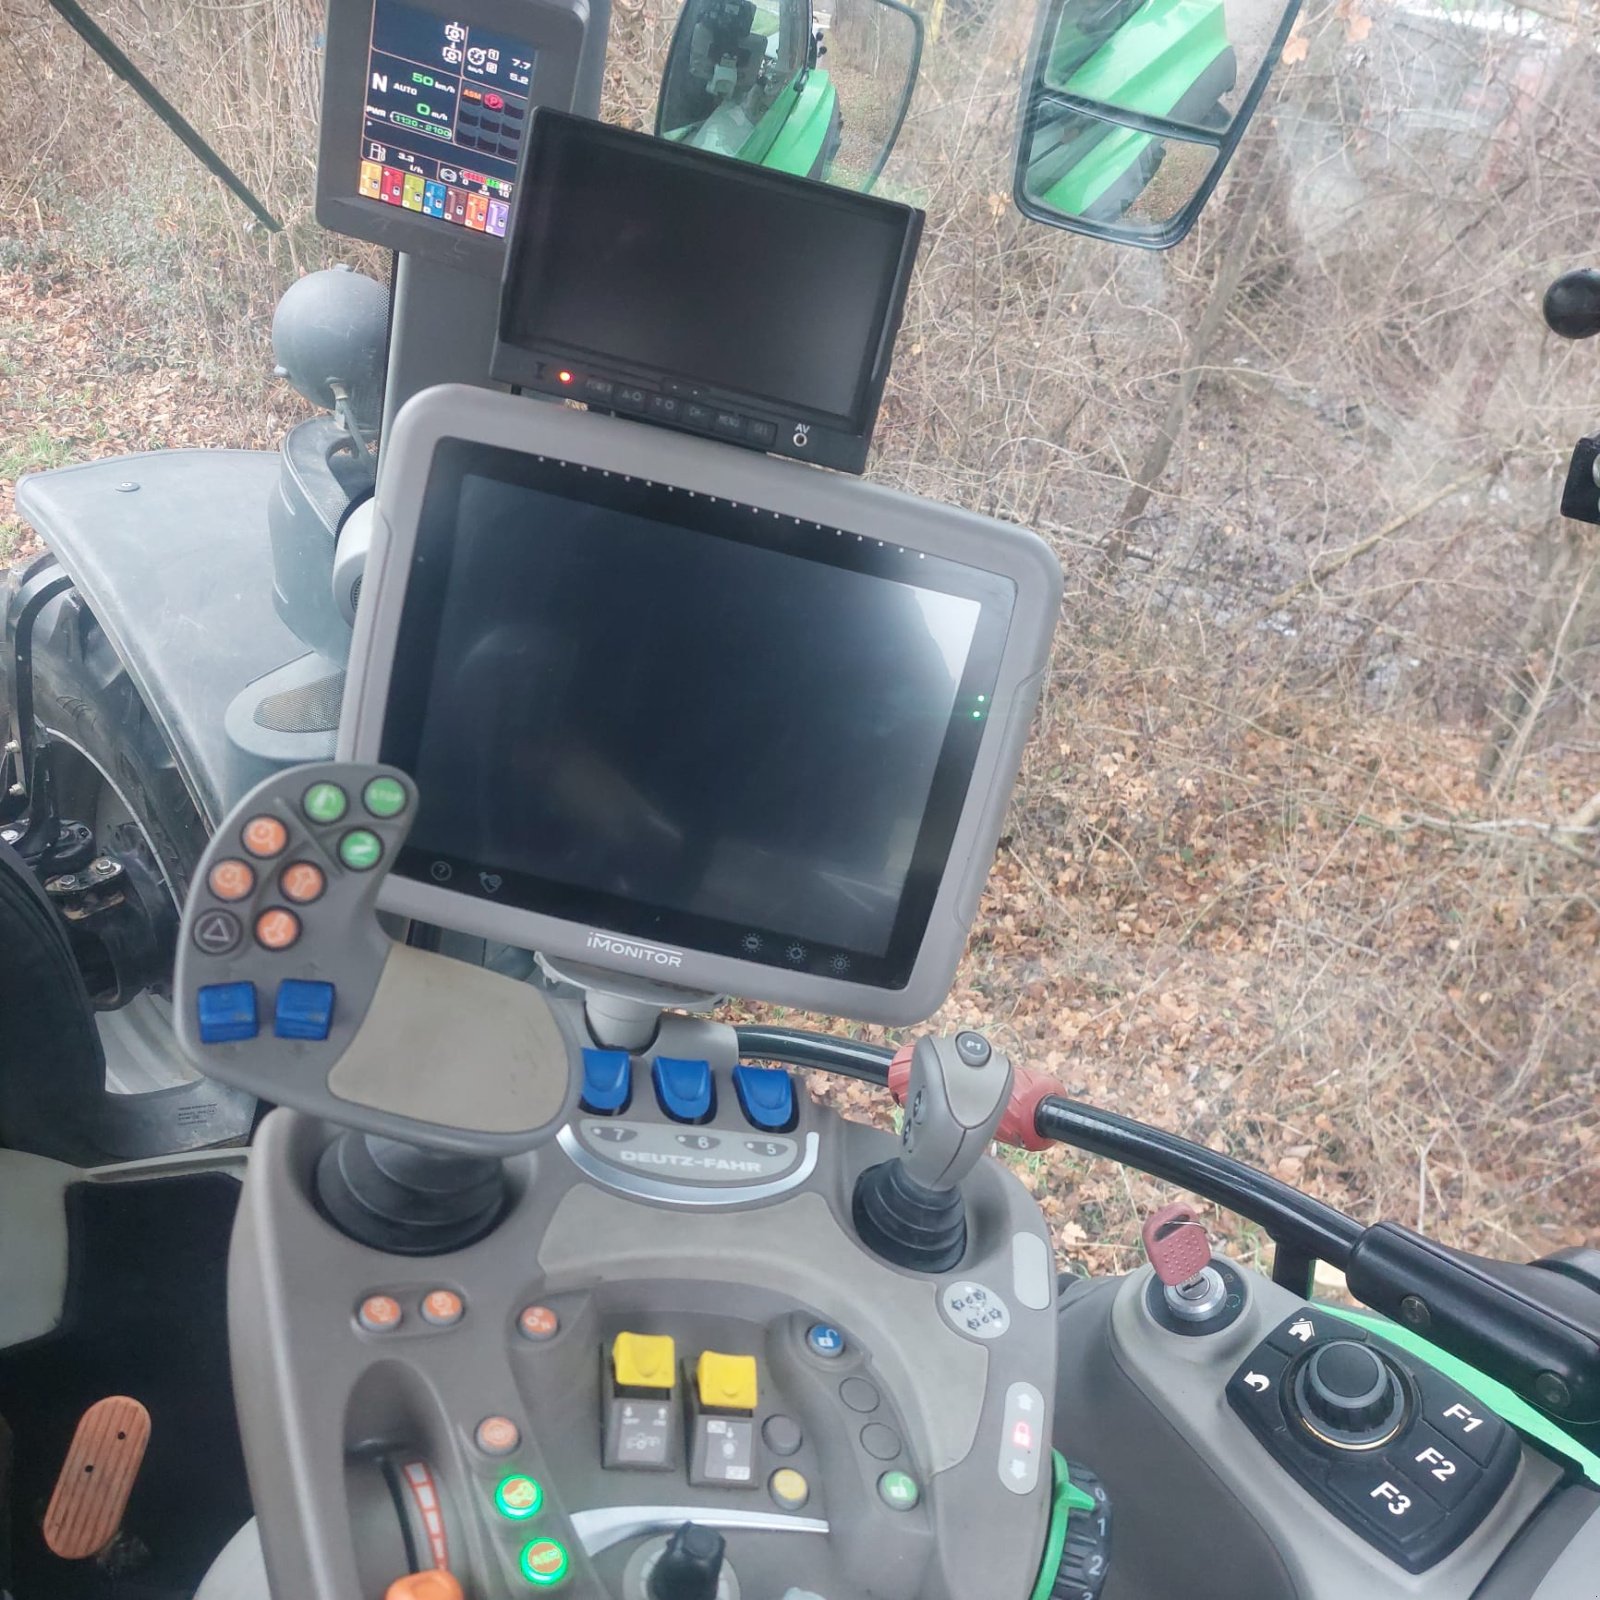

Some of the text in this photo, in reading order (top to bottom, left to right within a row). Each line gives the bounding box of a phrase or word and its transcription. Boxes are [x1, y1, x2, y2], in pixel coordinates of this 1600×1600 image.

[512, 58, 532, 70] 7.7
[372, 72, 388, 93] N
[412, 72, 456, 94] 50 km/h
[509, 72, 529, 85] 5.2
[393, 82, 417, 95] AUTO
[463, 88, 481, 100] ASM
[366, 105, 386, 117] PWR
[416, 103, 448, 121] 0 m/h
[425, 124, 450, 137] 2100
[498, 190, 510, 198] 10
[795, 423, 810, 434] AV
[586, 931, 682, 968] iMONITOR
[614, 1128, 777, 1155] 7 6 5
[619, 1150, 763, 1173] DEUTZ-FAHR
[1442, 1402, 1484, 1433] F1
[1415, 1446, 1457, 1482] F2
[1094, 1486, 1108, 1502] 0
[1370, 1480, 1412, 1516] F3
[1097, 1517, 1106, 1537] 1
[1088, 1555, 1104, 1576] 2
